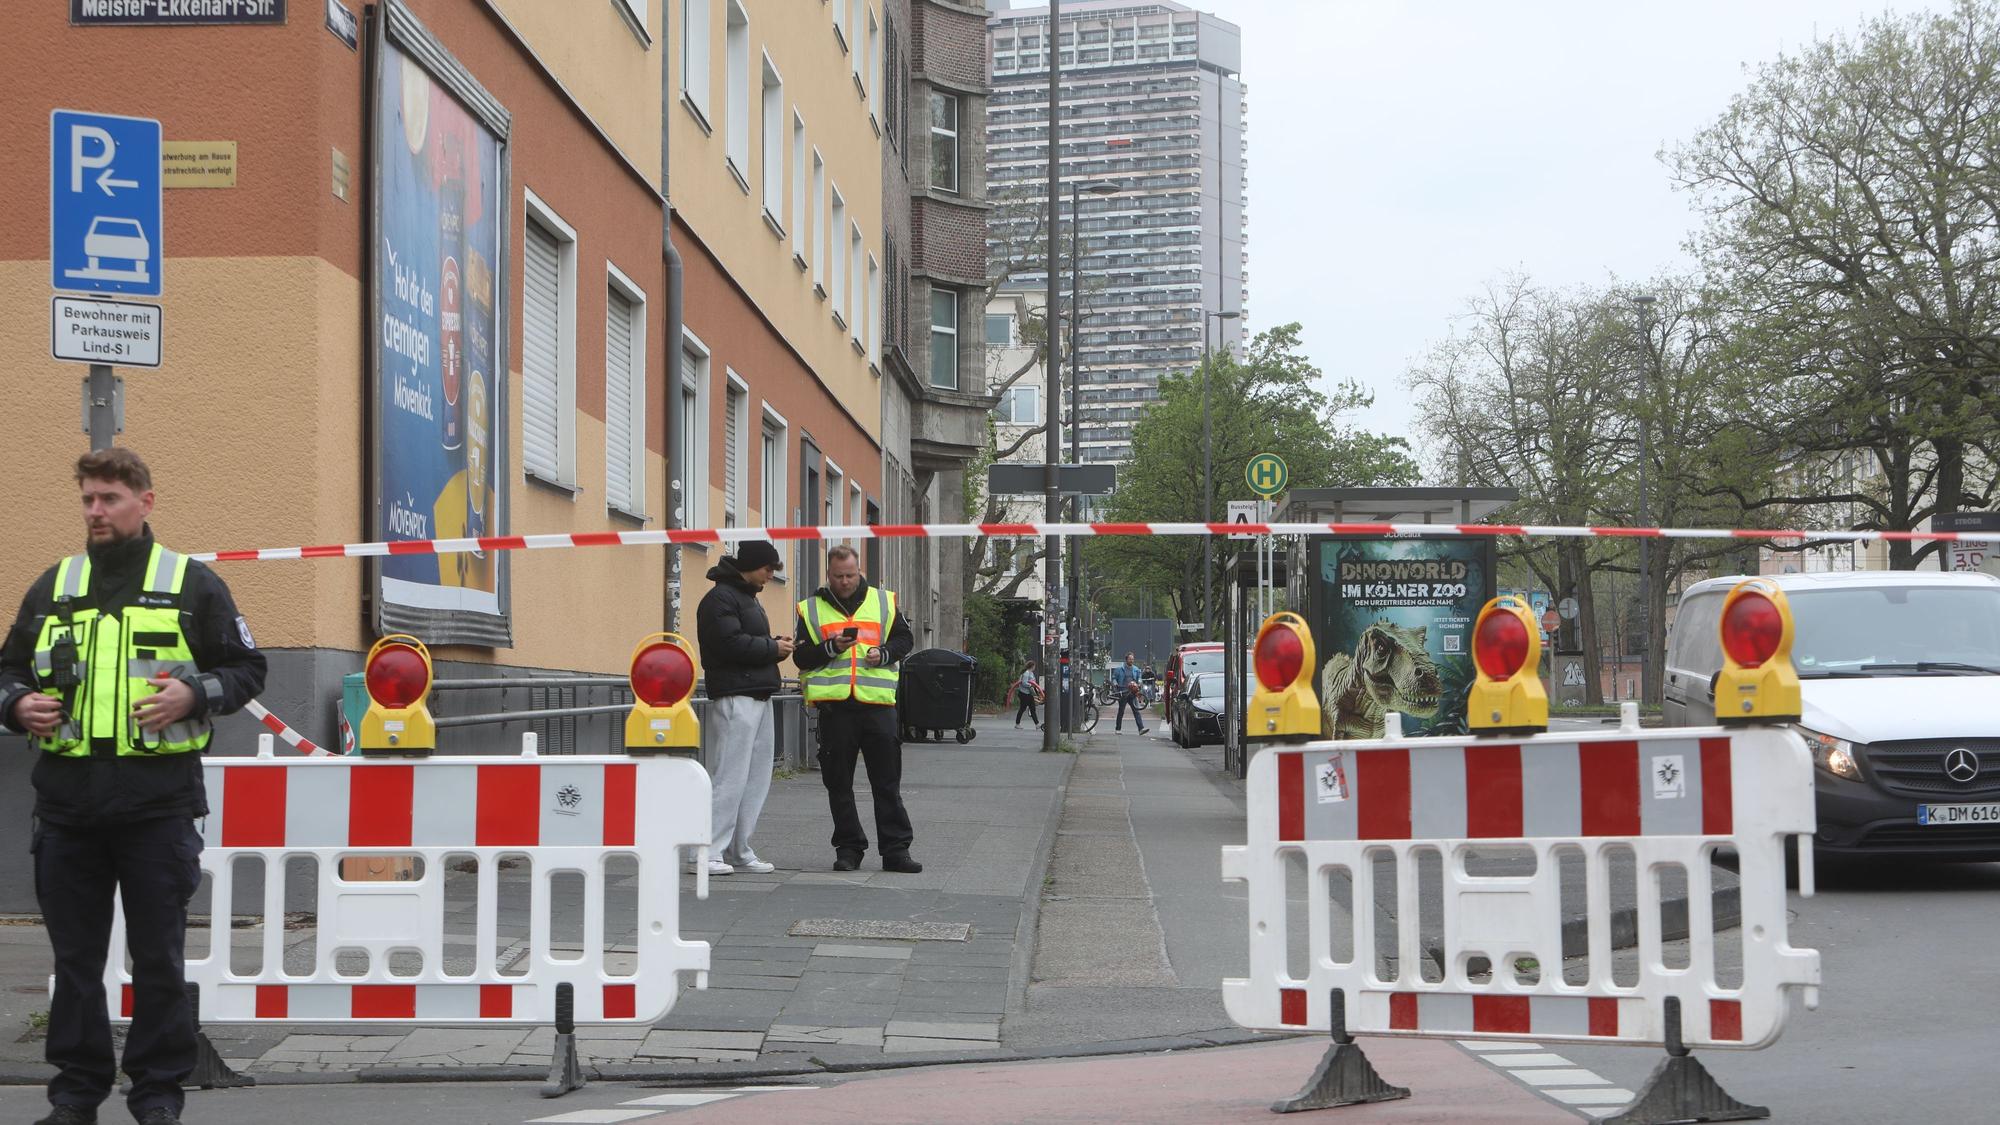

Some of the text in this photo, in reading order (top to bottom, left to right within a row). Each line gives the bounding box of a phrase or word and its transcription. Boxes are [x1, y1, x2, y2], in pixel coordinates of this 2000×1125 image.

[71, 124, 116, 192] P
[162, 153, 196, 162] atwerbung
[395, 262, 409, 303] Hol
[409, 269, 419, 309] dir
[420, 277, 433, 318] den
[64, 306, 151, 324] Bewohner mit
[71, 323, 150, 340] Parkausweis
[83, 341, 123, 355] Lind-S
[383, 313, 430, 377] cremigen
[1257, 464, 1276, 485] H
[388, 500, 427, 540] MÖVENPICK
[1232, 513, 1252, 536] A
[1342, 562, 1466, 580] DINOWORLD
[1342, 581, 1466, 598] IM KÖLNER ZOO
[1928, 807, 1937, 821] K
[1948, 807, 1968, 821] DM
